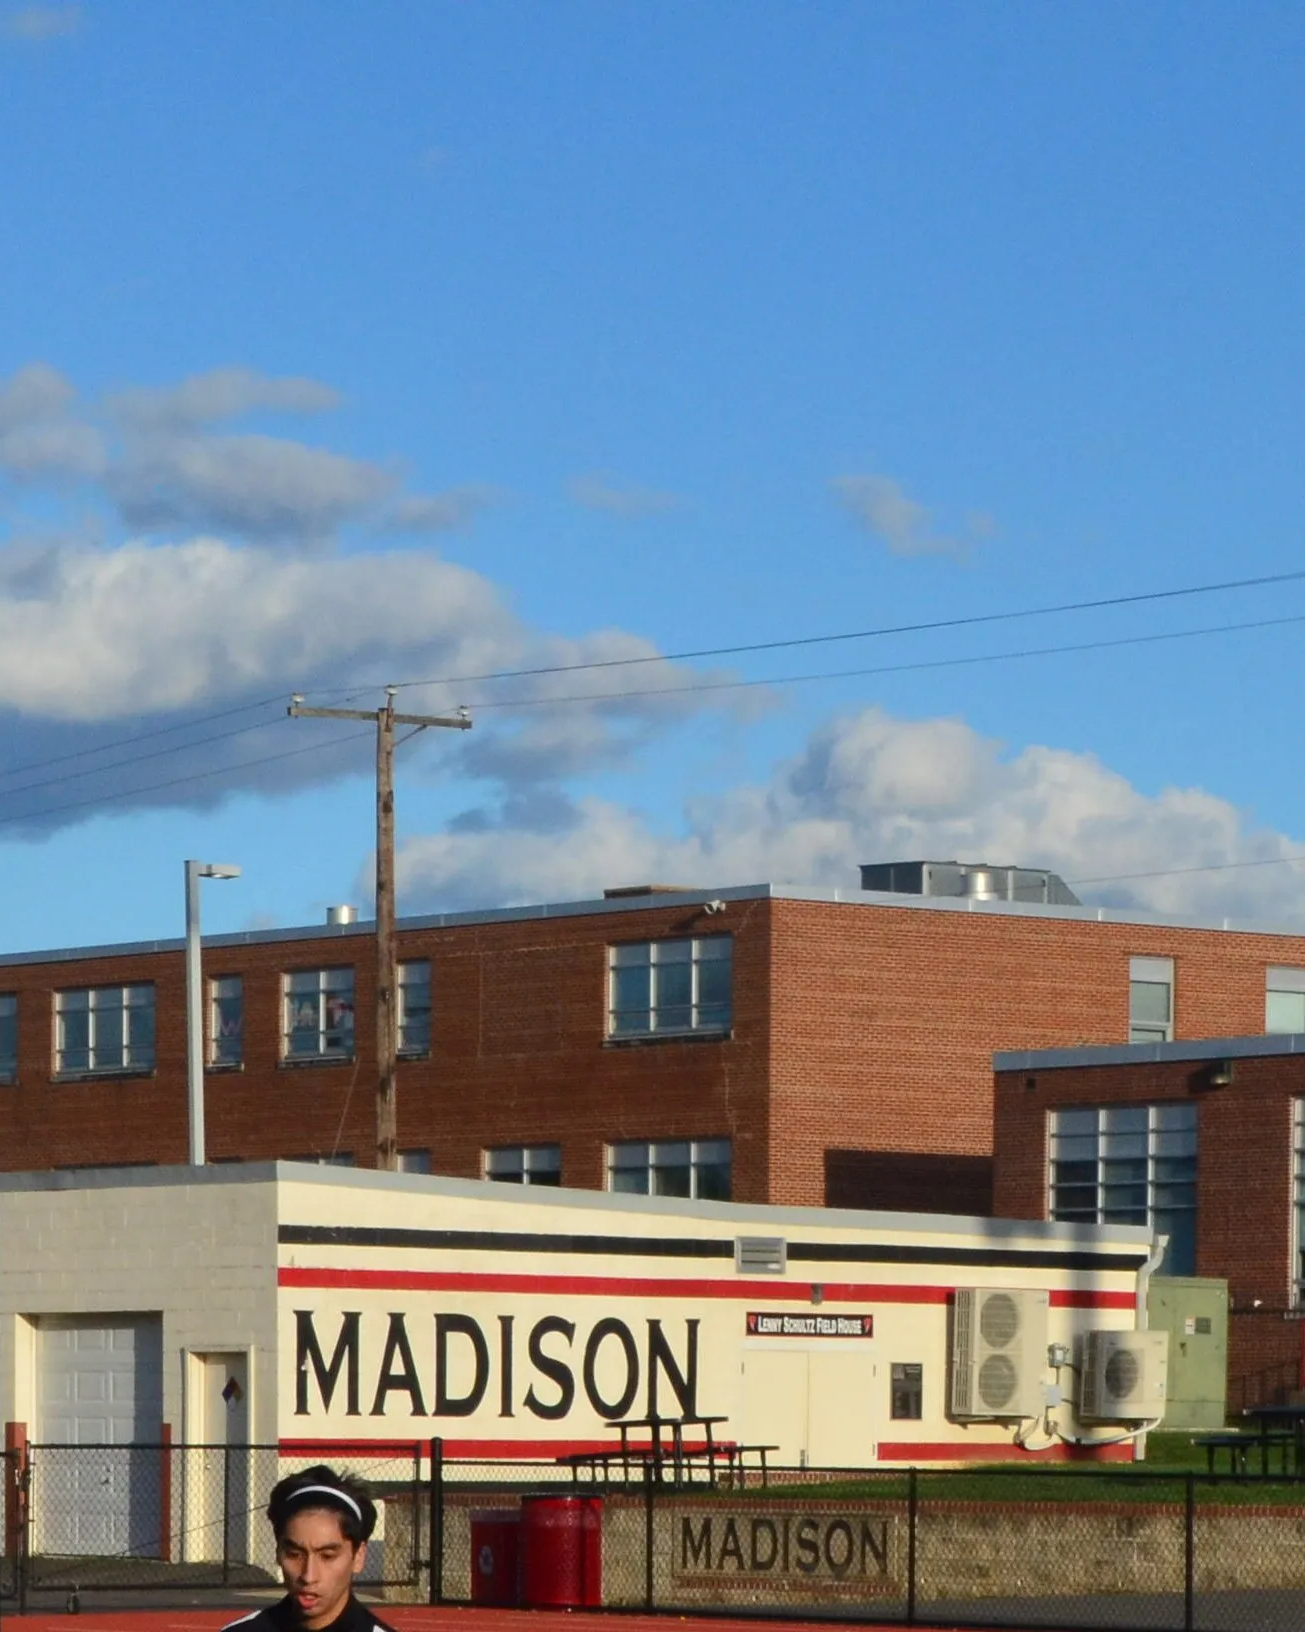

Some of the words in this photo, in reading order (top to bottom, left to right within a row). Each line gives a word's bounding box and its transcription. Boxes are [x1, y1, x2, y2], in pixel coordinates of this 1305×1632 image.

[757, 1315, 782, 1333] LENNY
[783, 1316, 815, 1334] SCHULTZ
[816, 1317, 837, 1335] FIELD
[837, 1317, 863, 1335] HOUSE
[293, 1310, 701, 1420] MADISON
[680, 1516, 889, 1576] MADISON
